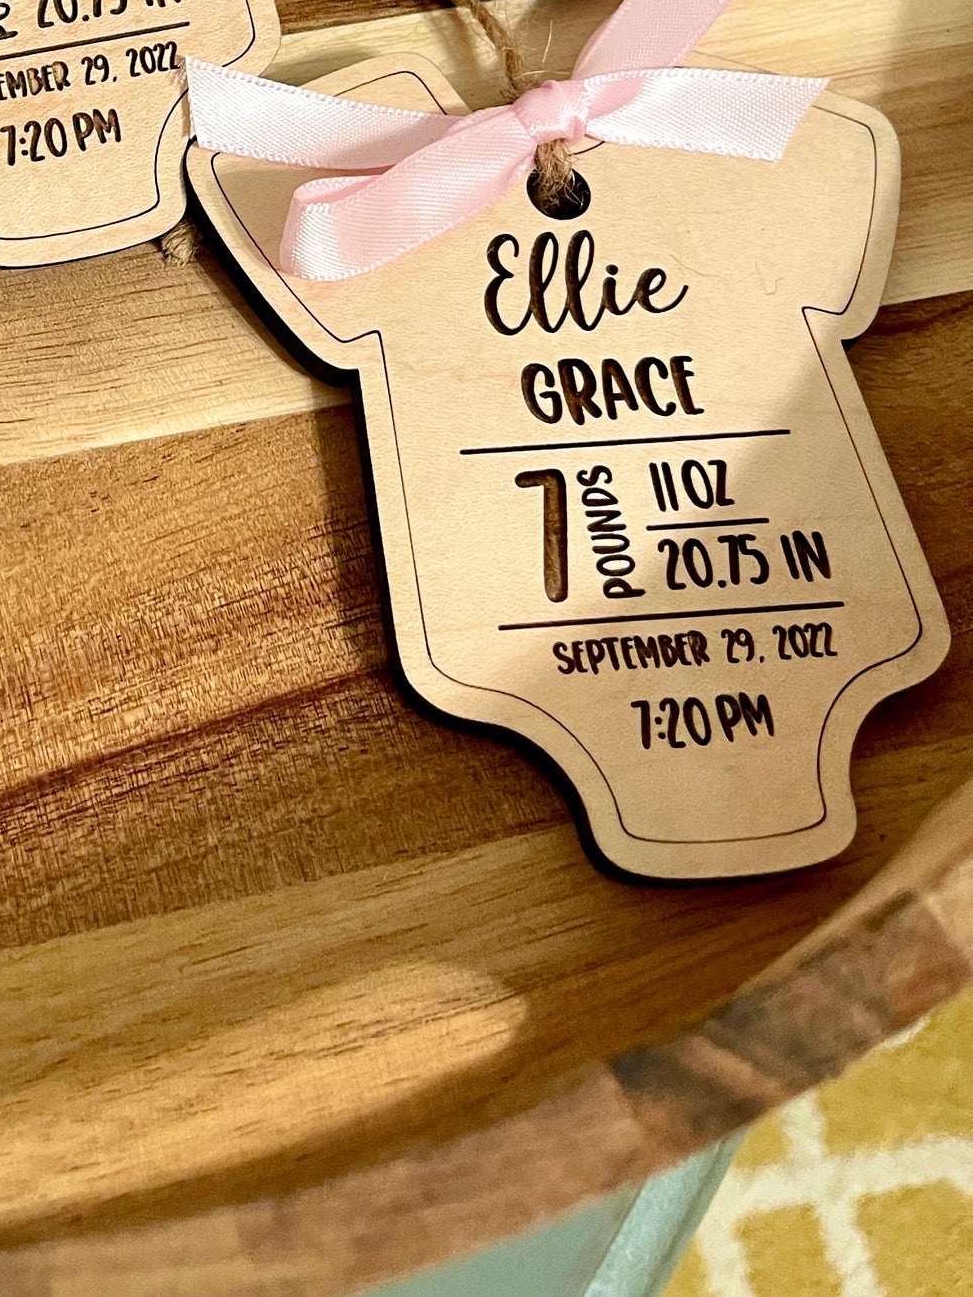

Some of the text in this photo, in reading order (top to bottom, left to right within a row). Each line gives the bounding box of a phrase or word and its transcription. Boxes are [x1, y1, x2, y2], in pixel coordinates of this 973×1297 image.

[126, 41, 181, 77] 2022
[0, 108, 122, 167] 7:20 PM
[484, 230, 689, 336] Ellie
[521, 355, 705, 425] GRACE
[514, 468, 568, 603] 7
[576, 465, 645, 599] POUNDS
[657, 530, 831, 590] 20.75 IN
[552, 629, 710, 675] SEPTEMBER
[772, 622, 837, 660] 2022
[631, 692, 775, 750] 7:20 PM
